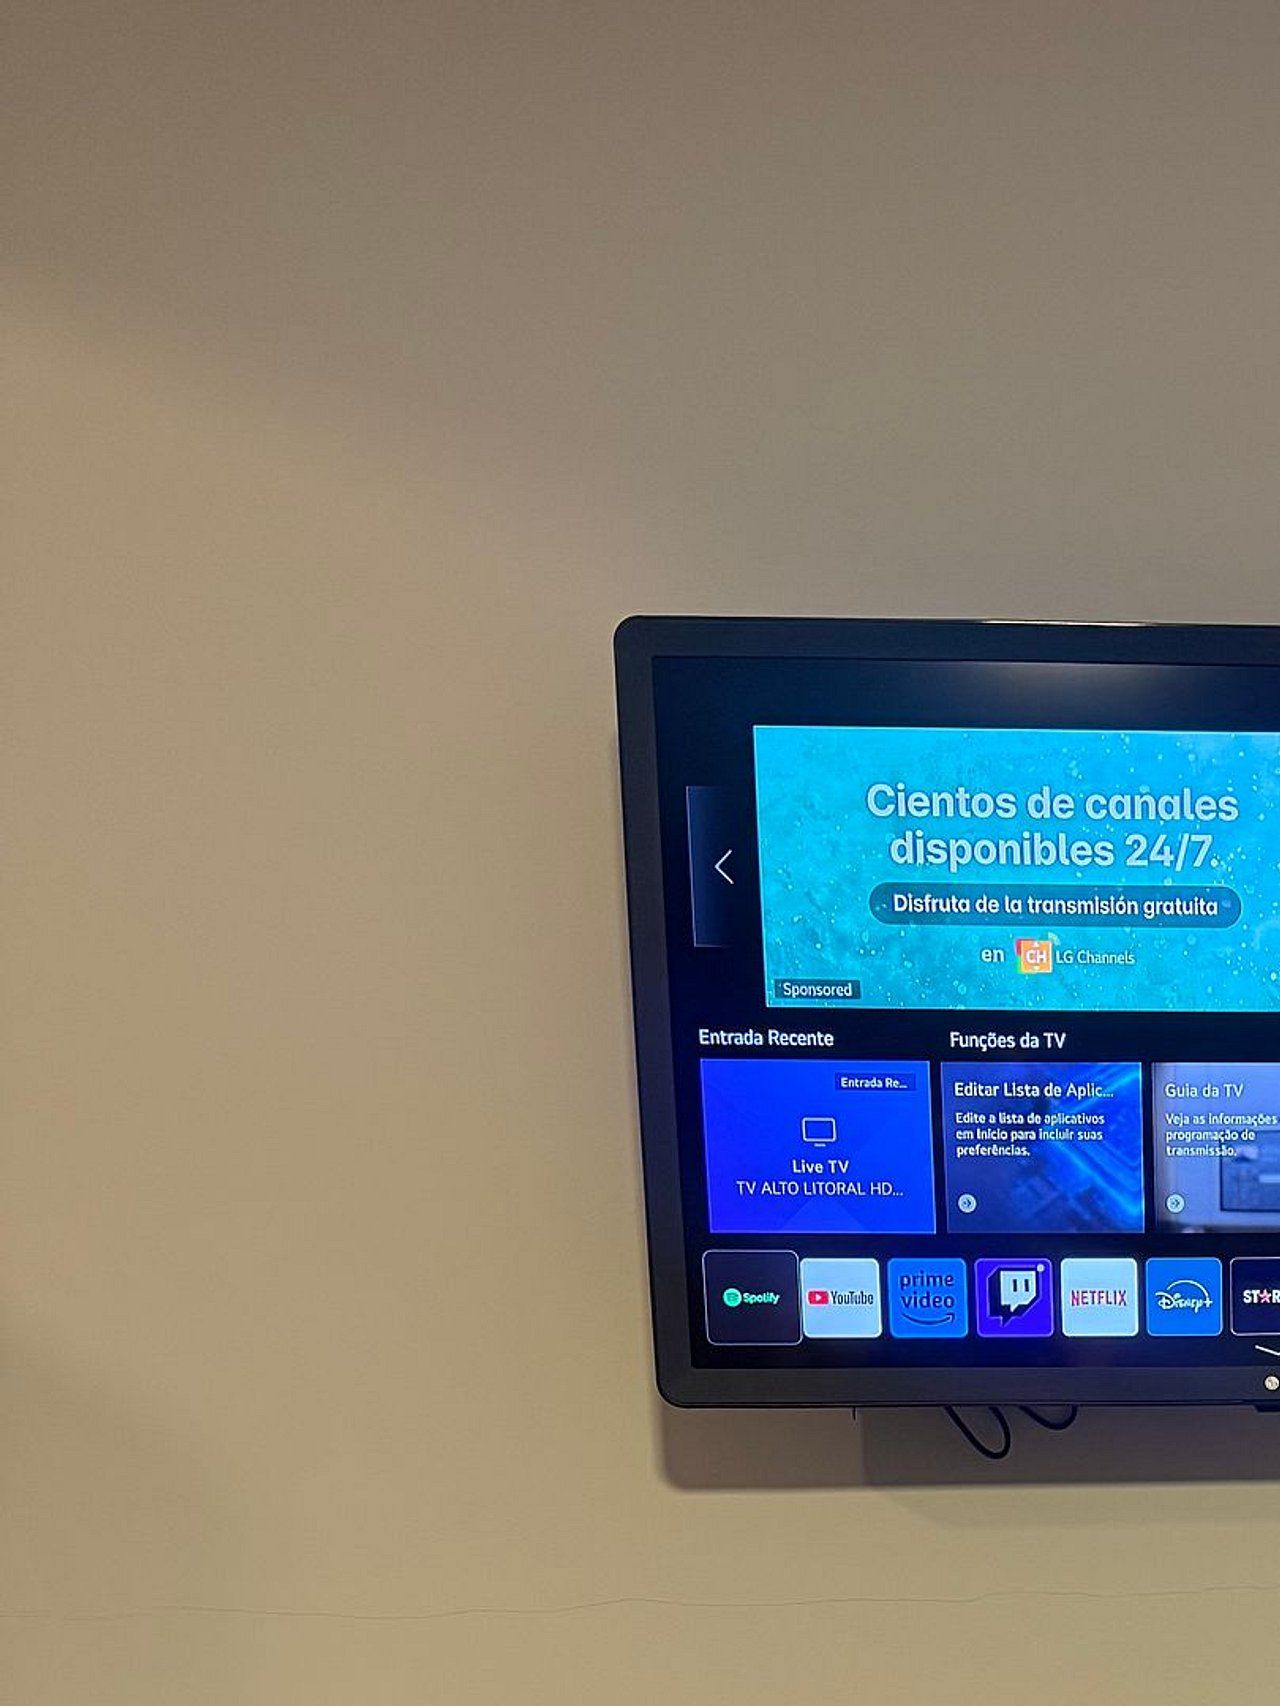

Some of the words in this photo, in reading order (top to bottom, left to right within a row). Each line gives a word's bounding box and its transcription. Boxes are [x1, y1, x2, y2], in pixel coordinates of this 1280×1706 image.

[866, 783, 1017, 818] Cientos
[1027, 785, 1076, 819] de
[1085, 788, 1239, 821] canales
[890, 831, 1115, 872] disponibles
[893, 894, 970, 915] Disfruta
[975, 896, 1000, 915] de
[1004, 896, 1023, 915] la
[1026, 895, 1138, 917] transmisión
[1143, 897, 1218, 919] gratuita
[981, 948, 1005, 963] en
[1026, 950, 1047, 964] CH
[1056, 950, 1073, 964] LG
[1077, 950, 1135, 965] Channels
[782, 981, 853, 999] Sponsored
[699, 1029, 764, 1047] Entrada
[768, 1031, 834, 1047] Recente
[950, 1031, 1015, 1052] Funções
[1020, 1032, 1040, 1049] da
[1043, 1032, 1066, 1049] TV
[841, 1077, 883, 1089] Entrada
[954, 1082, 1000, 1097] Editar
[1004, 1082, 1040, 1097] Lista
[1044, 1082, 1062, 1097] de
[1165, 1083, 1198, 1098] Guia
[1202, 1083, 1220, 1098] da
[1223, 1083, 1244, 1098] TV
[956, 1113, 986, 1124] Edite
[989, 1115, 996, 1124] a
[999, 1113, 1025, 1124] lista
[1027, 1113, 1041, 1124] de
[1044, 1113, 1105, 1126] aplicativos
[1165, 1113, 1189, 1127] Veja
[1193, 1115, 1206, 1125] as
[1208, 1113, 1278, 1127] informações
[956, 1130, 974, 1140] em
[1010, 1130, 1036, 1142] para
[1039, 1128, 1074, 1140] incluir
[1077, 1130, 1103, 1140] suas
[1166, 1129, 1239, 1143] programação
[1241, 1129, 1255, 1141] de
[956, 1144, 1031, 1158] preferências.
[792, 1160, 825, 1174] Live
[828, 1160, 849, 1174] TV
[736, 1181, 757, 1195] TV
[761, 1181, 800, 1196] ALTO
[804, 1181, 865, 1196] LITORAL
[900, 1270, 955, 1291] prime
[743, 1291, 780, 1305] Spotify
[830, 1290, 874, 1305] YouTube
[900, 1291, 955, 1309] video
[1071, 1289, 1127, 1307] NETFLIX
